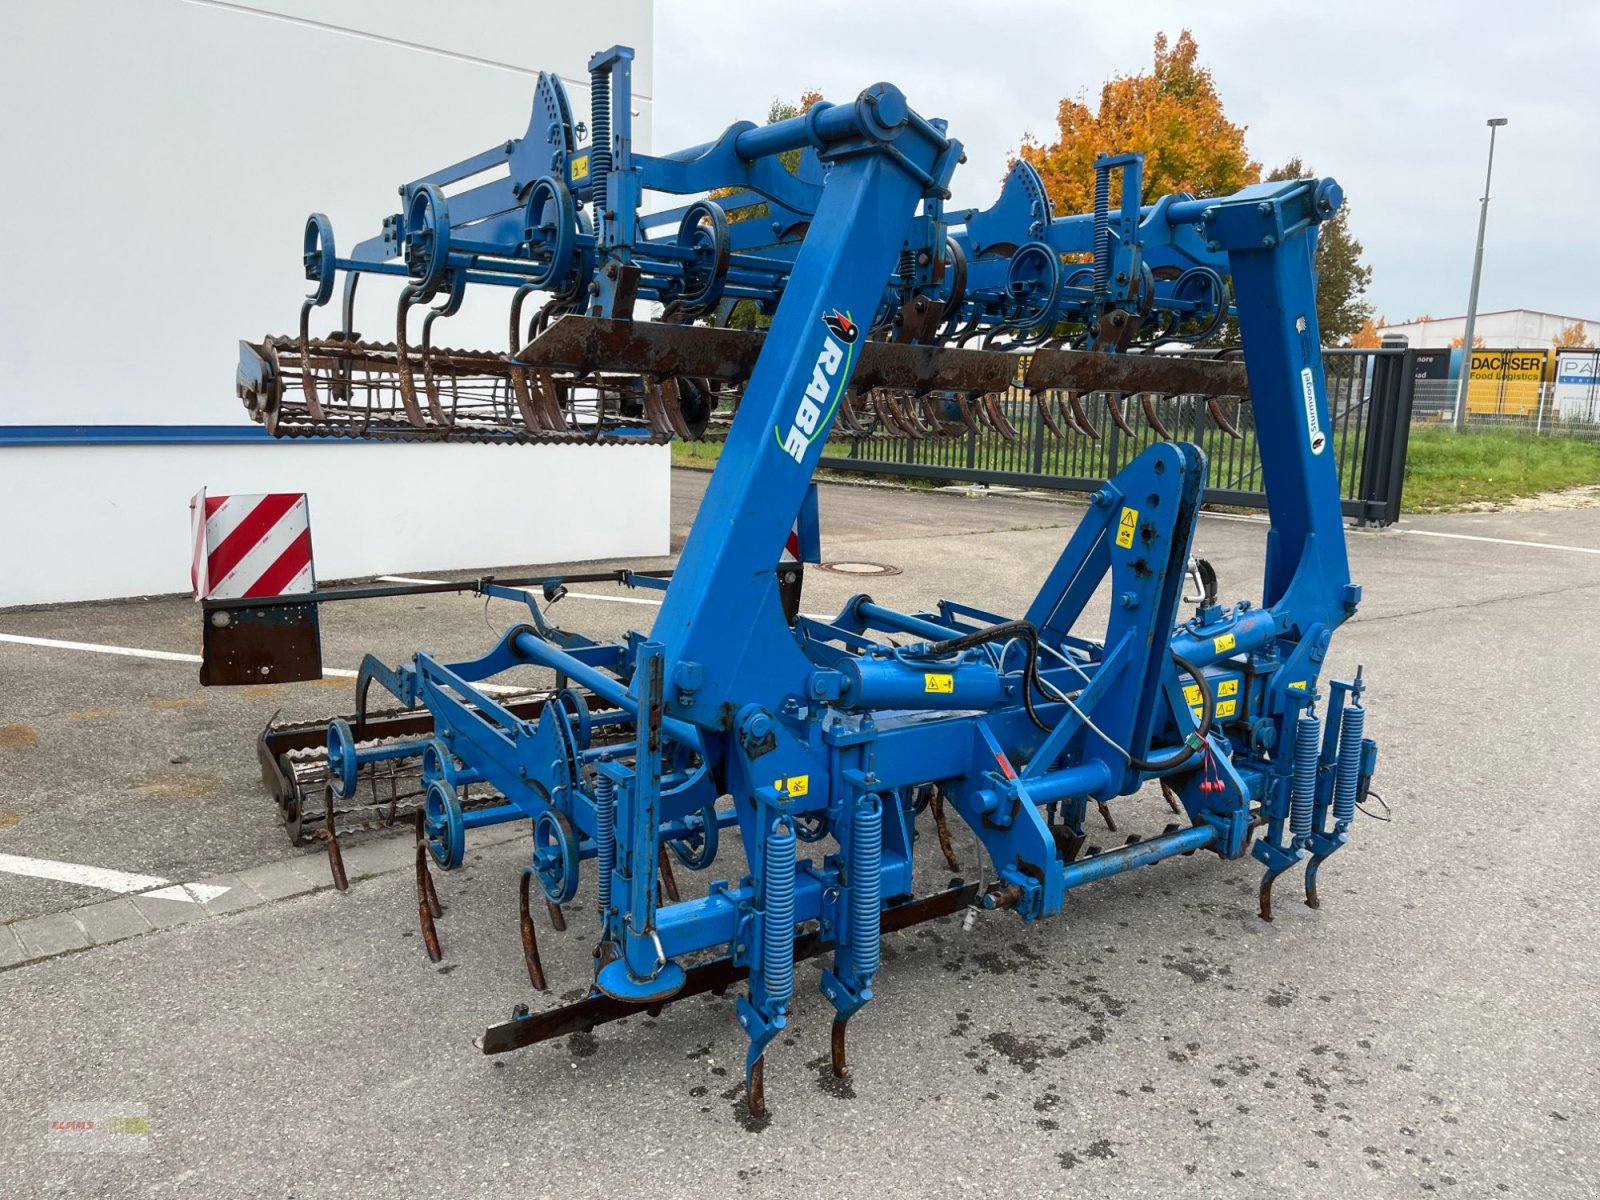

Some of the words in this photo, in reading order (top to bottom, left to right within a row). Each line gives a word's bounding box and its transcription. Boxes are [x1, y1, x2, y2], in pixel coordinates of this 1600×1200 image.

[1470, 371, 1493, 380] Food
[1496, 372, 1538, 381] Logistics
[1471, 357, 1540, 371] DACHSER
[784, 336, 843, 464] RABE
[1303, 372, 1316, 432] Sturmvogel
